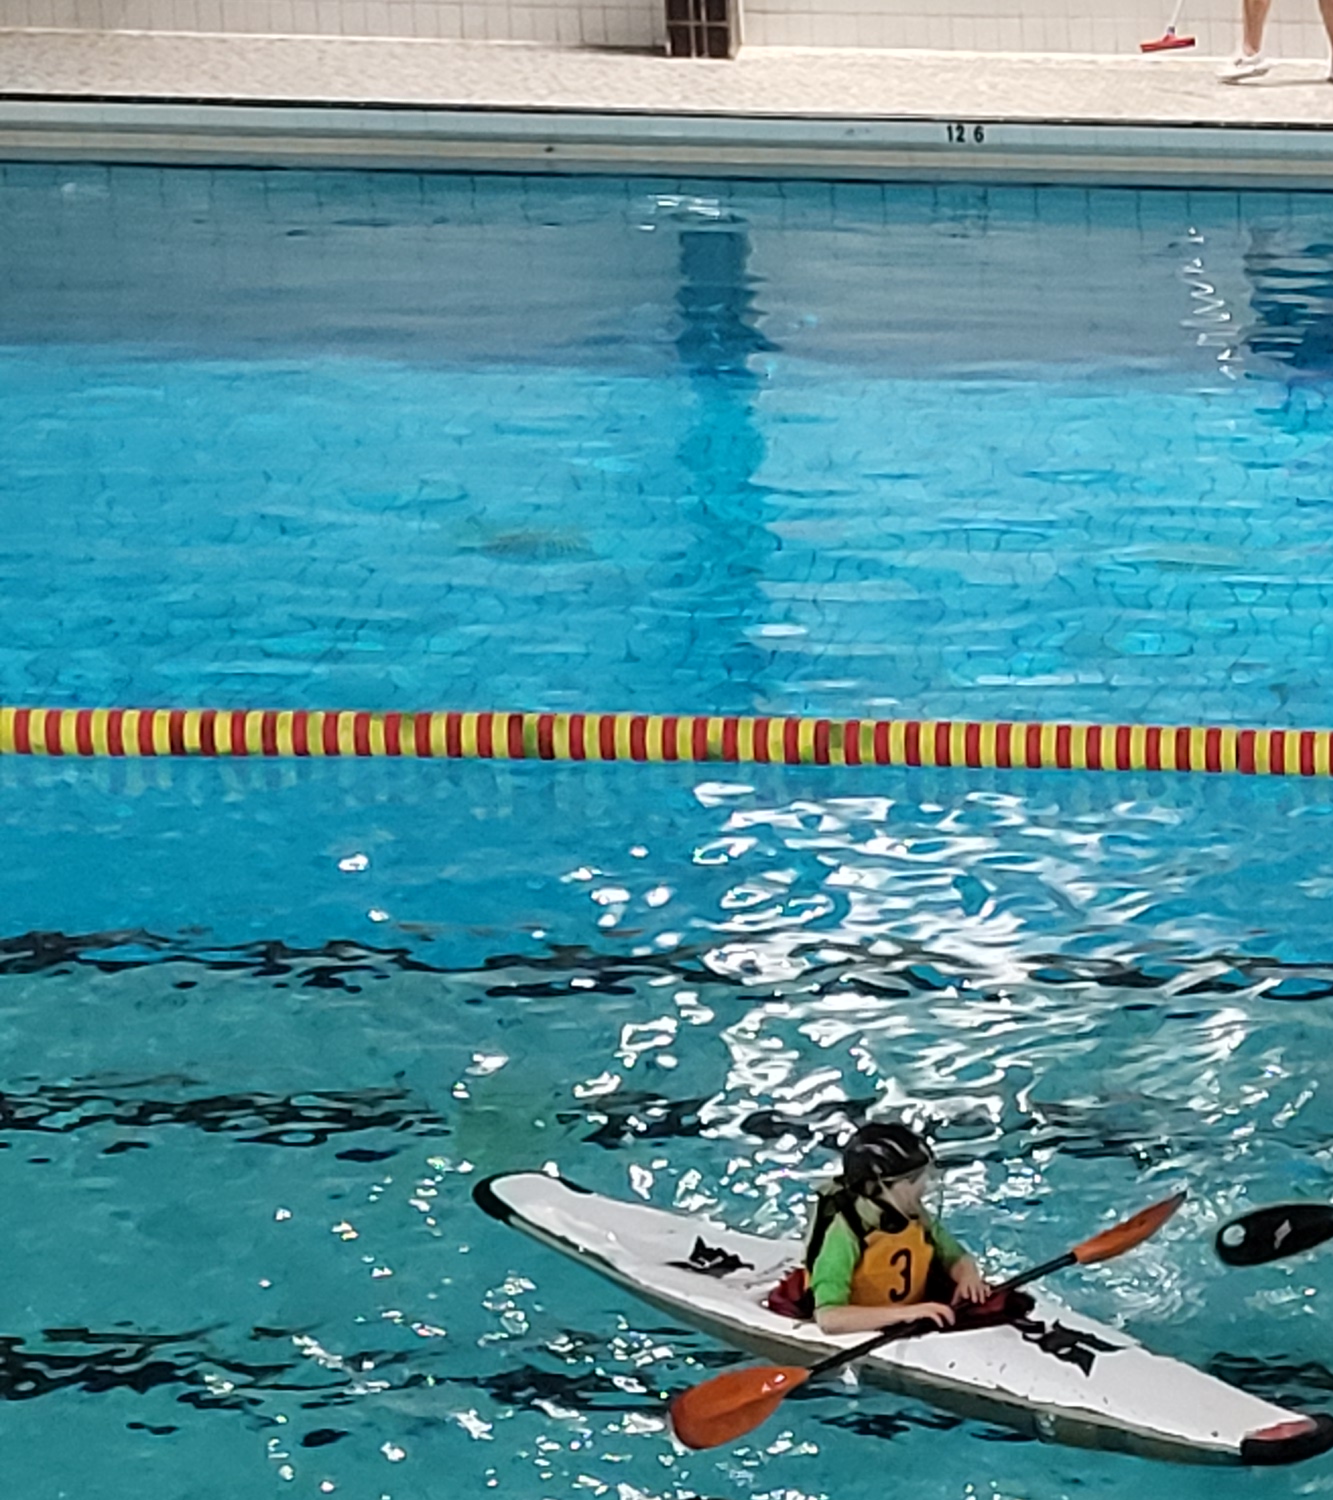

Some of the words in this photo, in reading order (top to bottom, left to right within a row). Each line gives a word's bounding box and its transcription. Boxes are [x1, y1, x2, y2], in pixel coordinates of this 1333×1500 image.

[946, 124, 966, 143] 12
[973, 125, 985, 144] 6
[889, 1247, 912, 1303] 3
